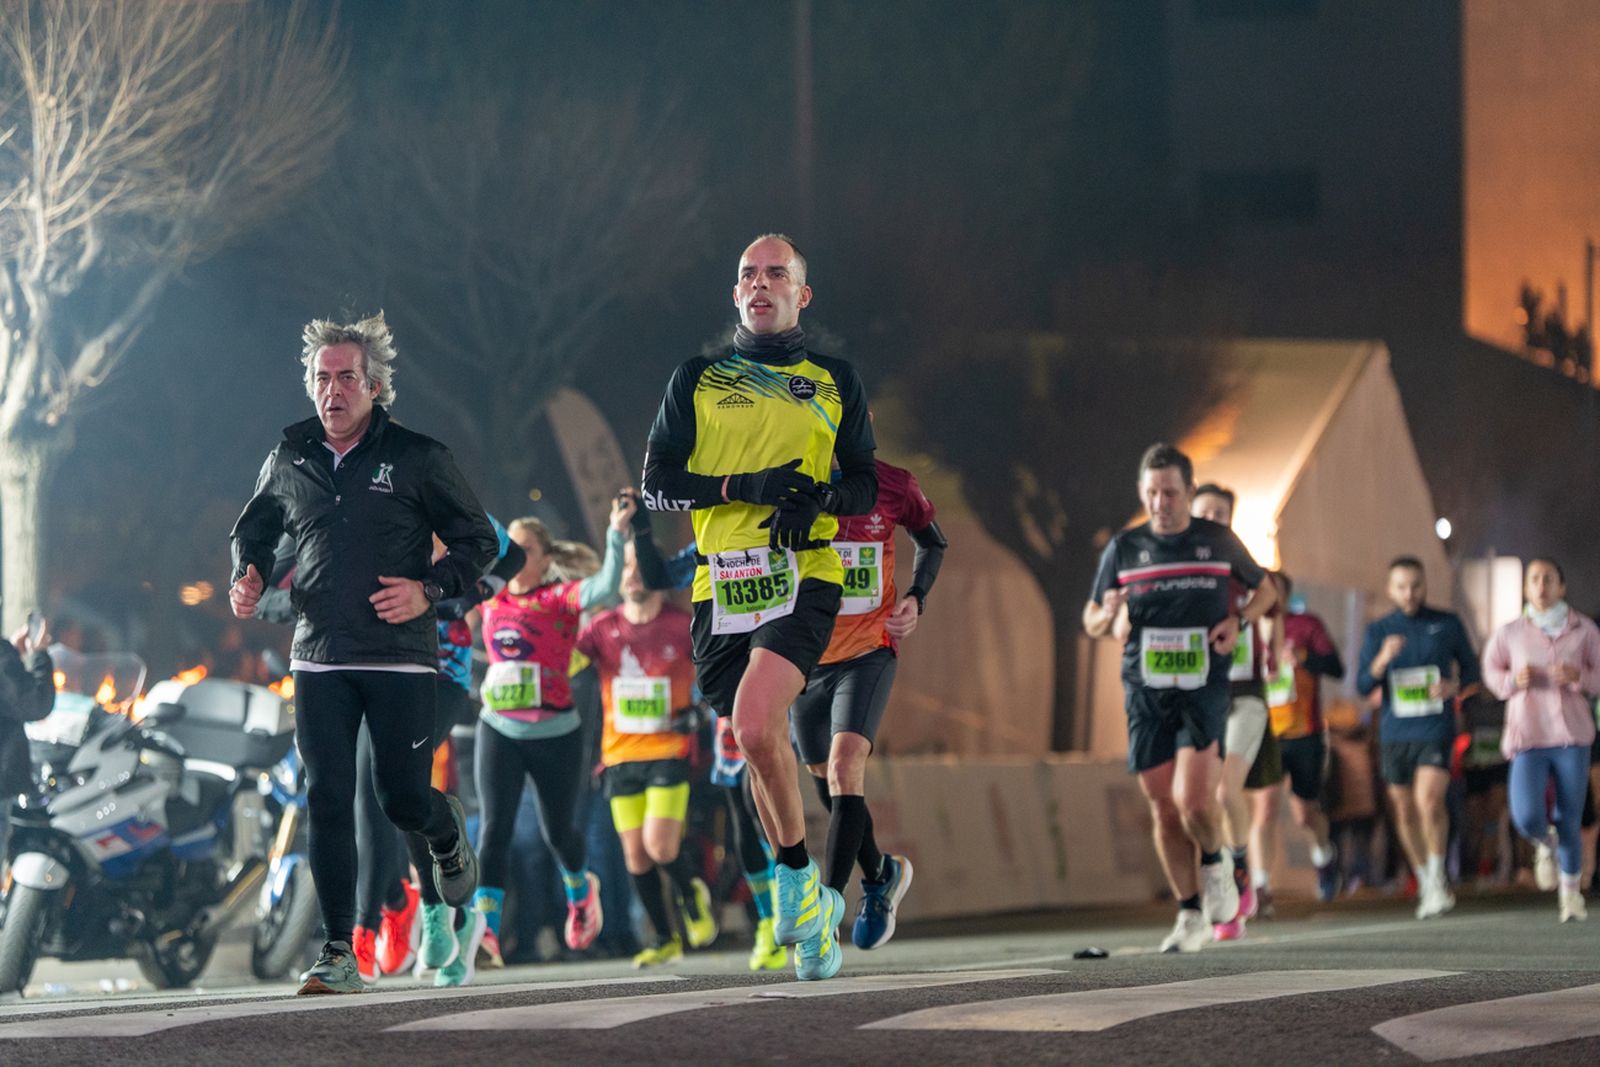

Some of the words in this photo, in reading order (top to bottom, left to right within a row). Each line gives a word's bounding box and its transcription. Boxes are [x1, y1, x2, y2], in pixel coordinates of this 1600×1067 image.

[643, 490, 695, 511] aluz
[721, 572, 789, 606] 13385
[845, 567, 870, 590] 49
[1154, 651, 1197, 669] 7360
